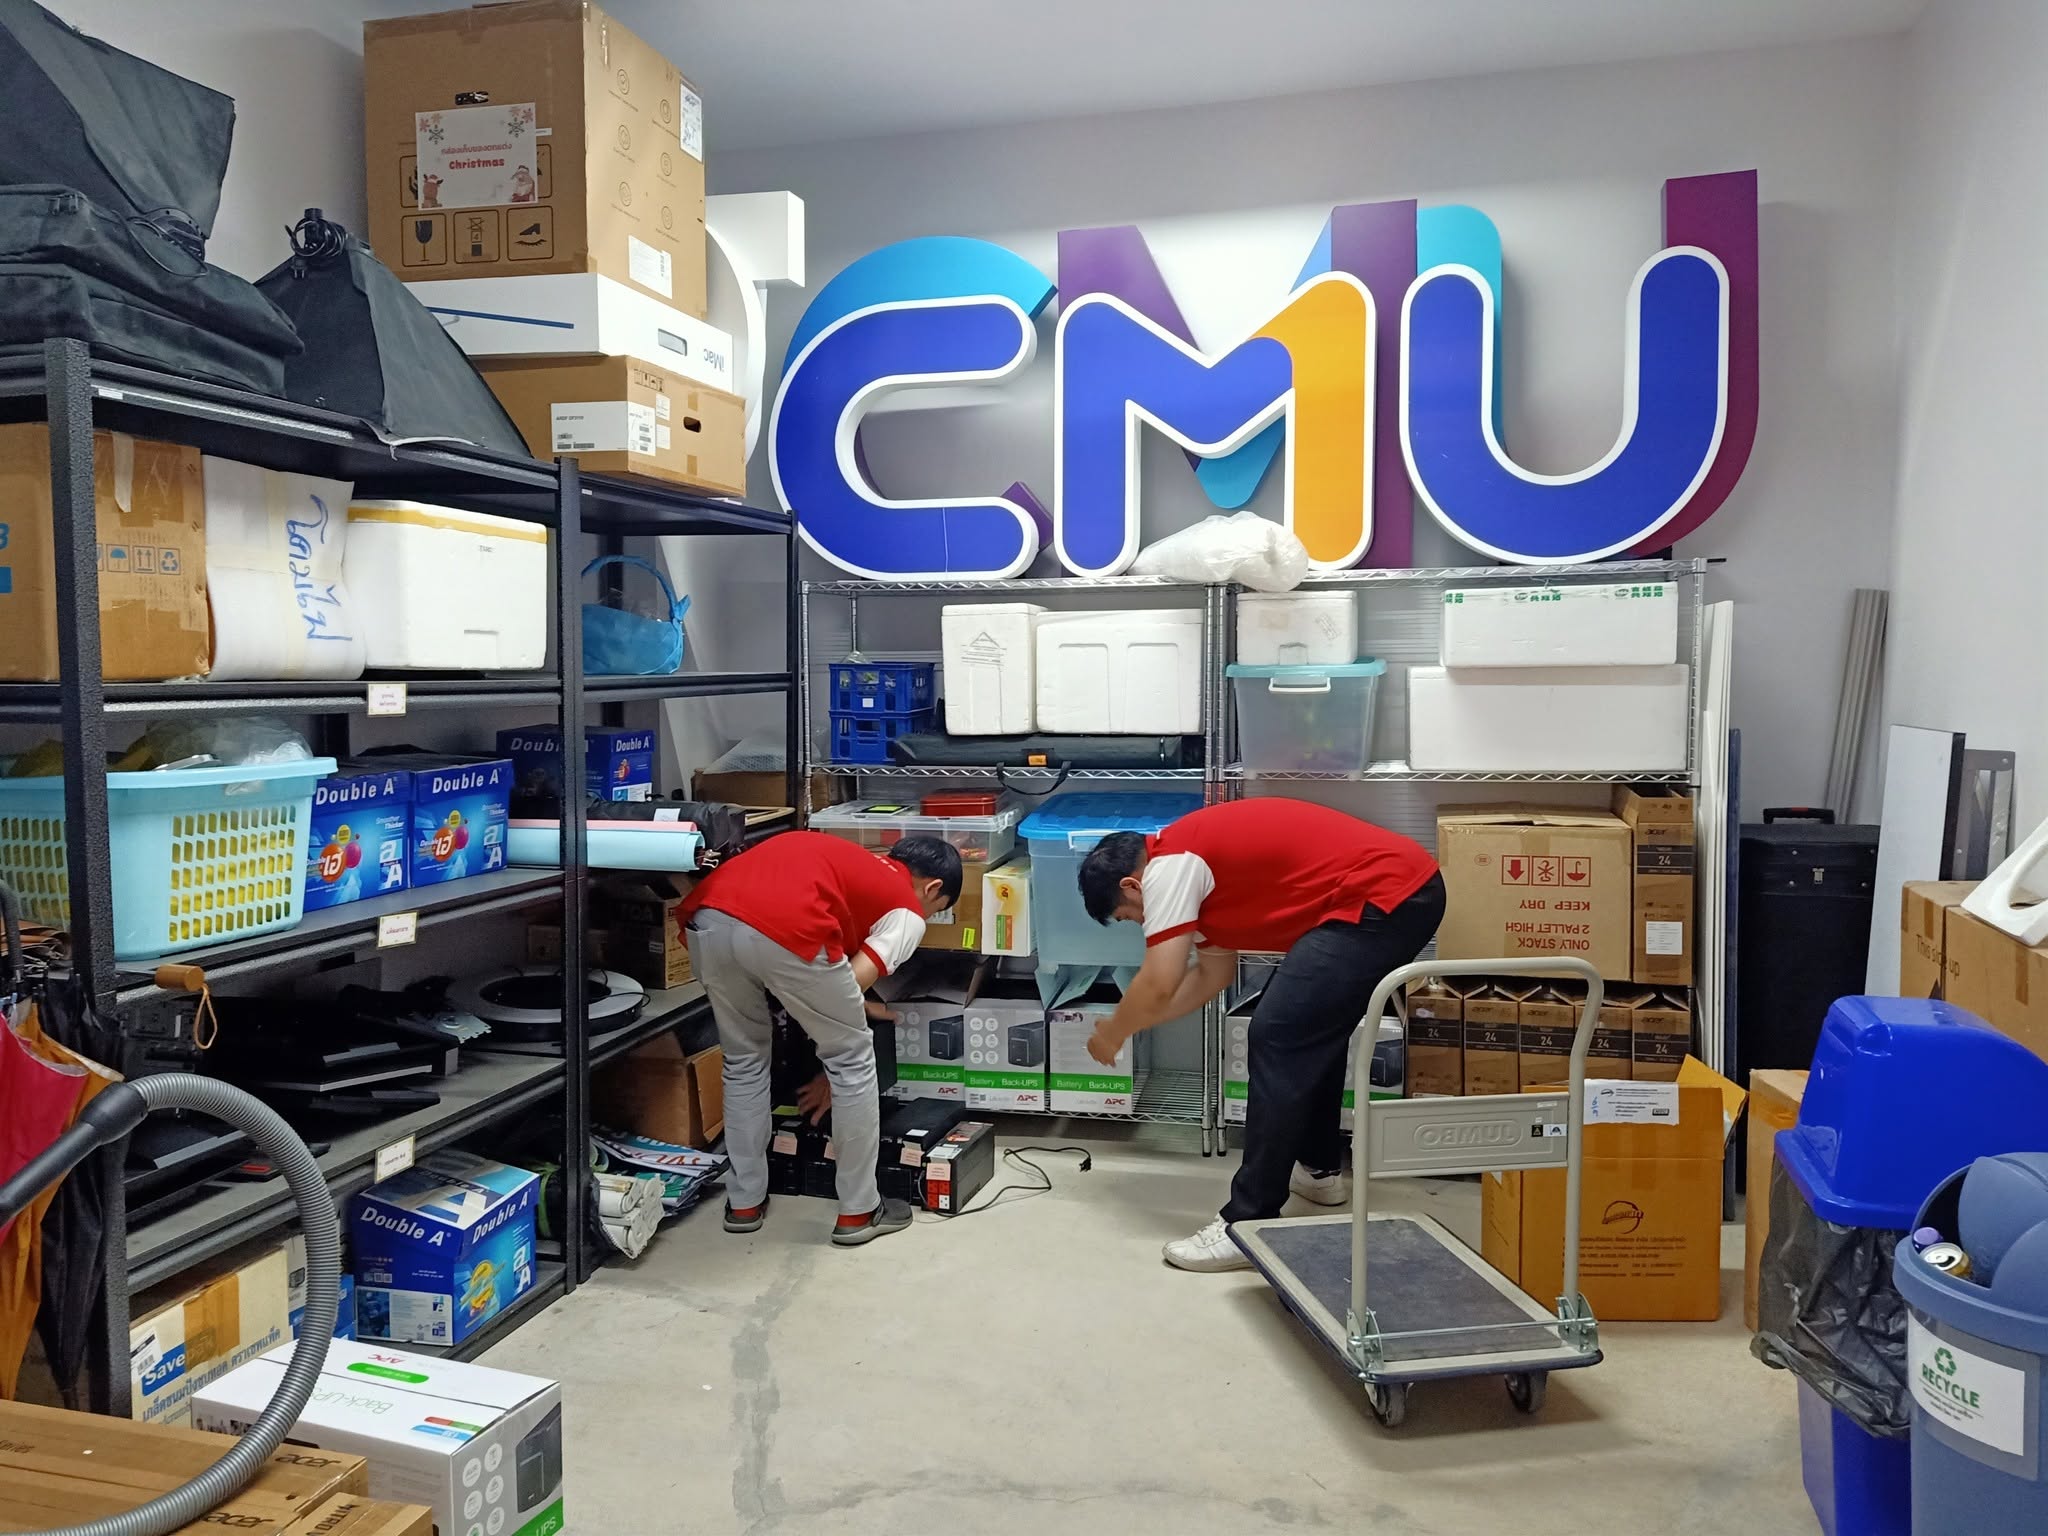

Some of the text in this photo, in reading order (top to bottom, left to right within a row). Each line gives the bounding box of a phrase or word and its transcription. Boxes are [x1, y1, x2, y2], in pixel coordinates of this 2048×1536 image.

[449, 158, 505, 170] Christmas
[703, 348, 725, 372] iMac
[768, 244, 1730, 583] CMU
[511, 738, 560, 752] Doubl
[616, 736, 650, 752] Double A
[432, 768, 499, 794] Double A
[316, 777, 395, 806] Double A
[1658, 855, 1671, 866] 24
[1519, 899, 1590, 911] KEEP DRY
[1505, 922, 1590, 934] 2 PALLET HIGH
[1517, 937, 1590, 950] ONLY STACK
[1949, 958, 1961, 981] up
[1427, 1028, 1439, 1038] 24
[1484, 1031, 1497, 1043] 24
[1540, 1036, 1553, 1047] 24
[1597, 1039, 1609, 1049] 24
[1655, 1043, 1668, 1055] 24
[923, 1070, 959, 1081] Back-UPS
[969, 1077, 1038, 1088] Battery Back-UPS
[1056, 1079, 1126, 1091] Battery Back-UPS
[937, 1087, 958, 1095] APC
[1016, 1094, 1038, 1102] APC
[1104, 1097, 1126, 1106] APC
[471, 1192, 529, 1245] Double A
[360, 1206, 445, 1246] Double A
[367, 1353, 407, 1364] APC
[1921, 1362, 1981, 1409] RECYCLE
[274, 1453, 342, 1468] acer
[202, 1511, 276, 1529] acer
